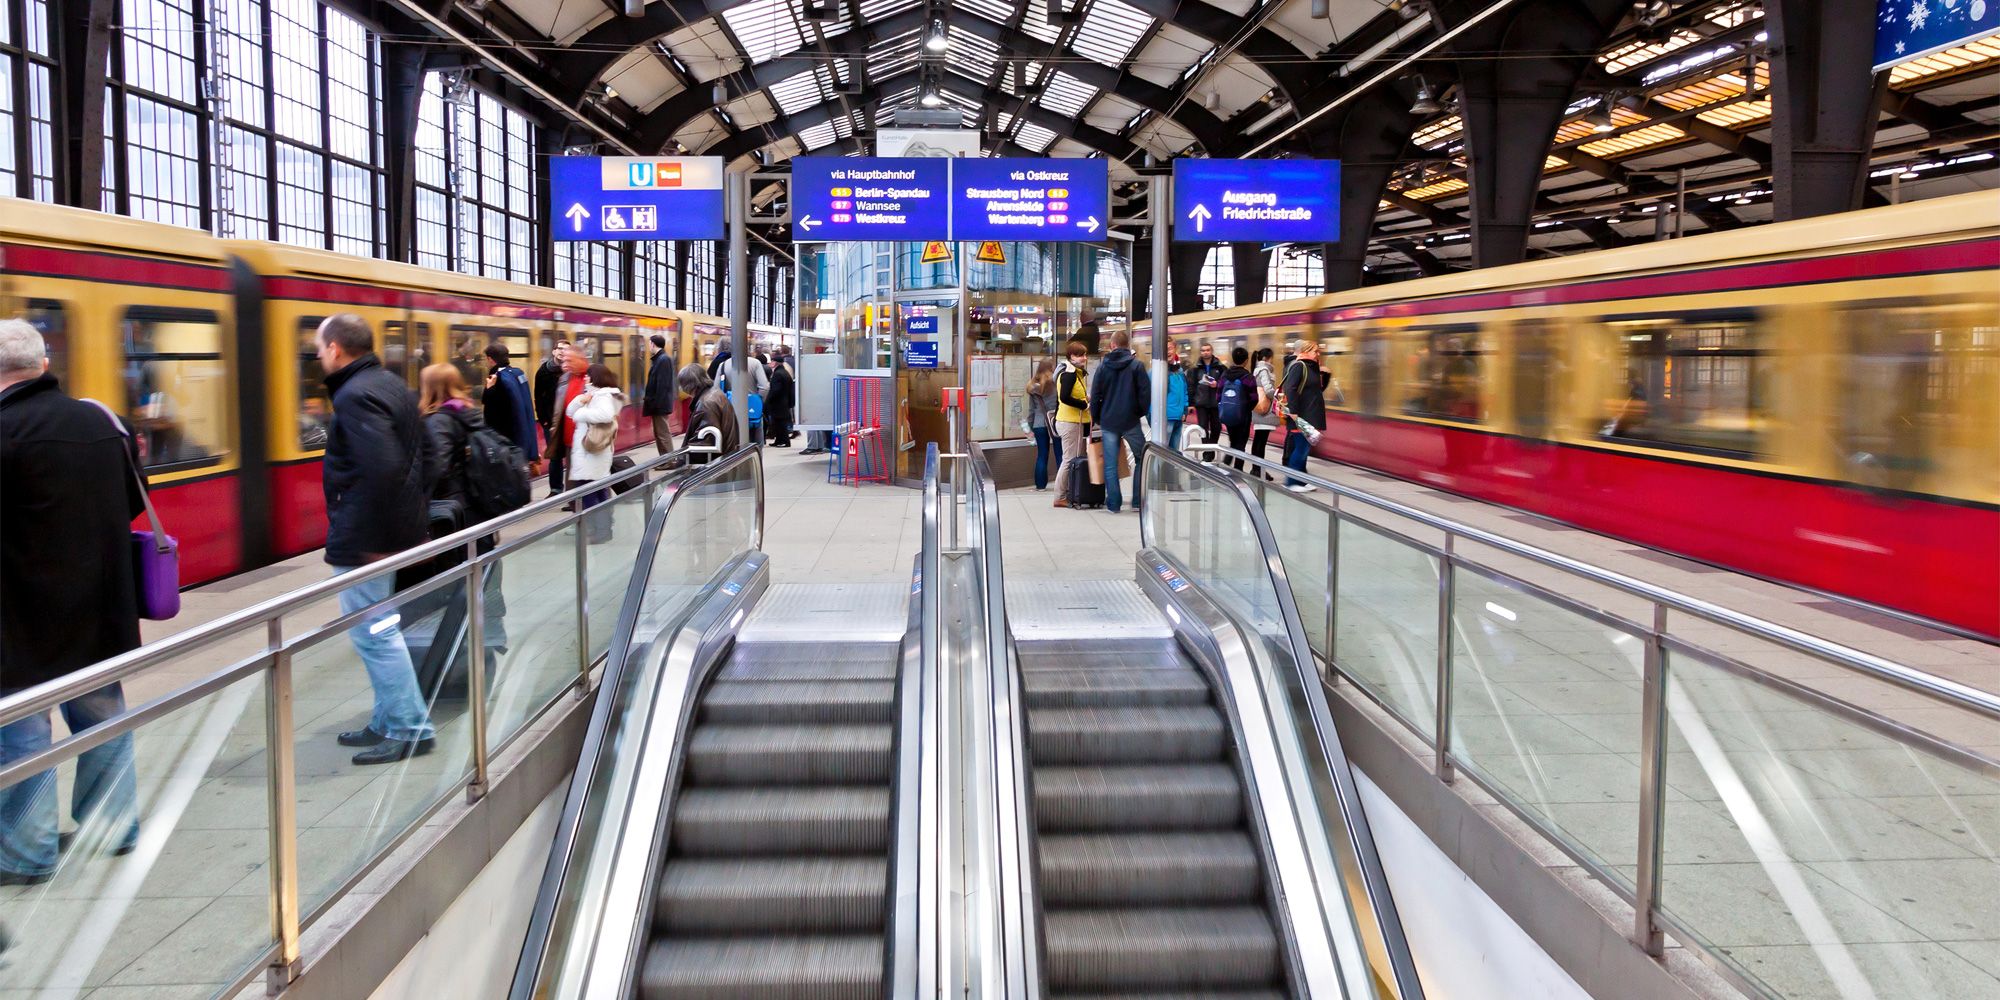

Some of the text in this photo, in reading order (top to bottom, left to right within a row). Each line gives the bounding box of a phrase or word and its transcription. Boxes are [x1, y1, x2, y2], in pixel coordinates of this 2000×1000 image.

[632, 164, 650, 186] U
[831, 169, 915, 181] via Hauptbahnhof
[1010, 170, 1069, 181] via Ostkreuz
[855, 187, 930, 199] Berlin-Spandau
[966, 188, 1019, 201] Strausberg
[1021, 188, 1045, 199] Nord
[1222, 190, 1277, 206] Ausgang
[856, 201, 901, 211] Wannsee
[986, 200, 1045, 212] Ahrensfelde
[855, 213, 907, 224] Westkreuz
[988, 213, 1045, 226] Wartenberg
[1222, 206, 1312, 221] Friedrichstraße
[909, 321, 930, 330] Aufsicht
